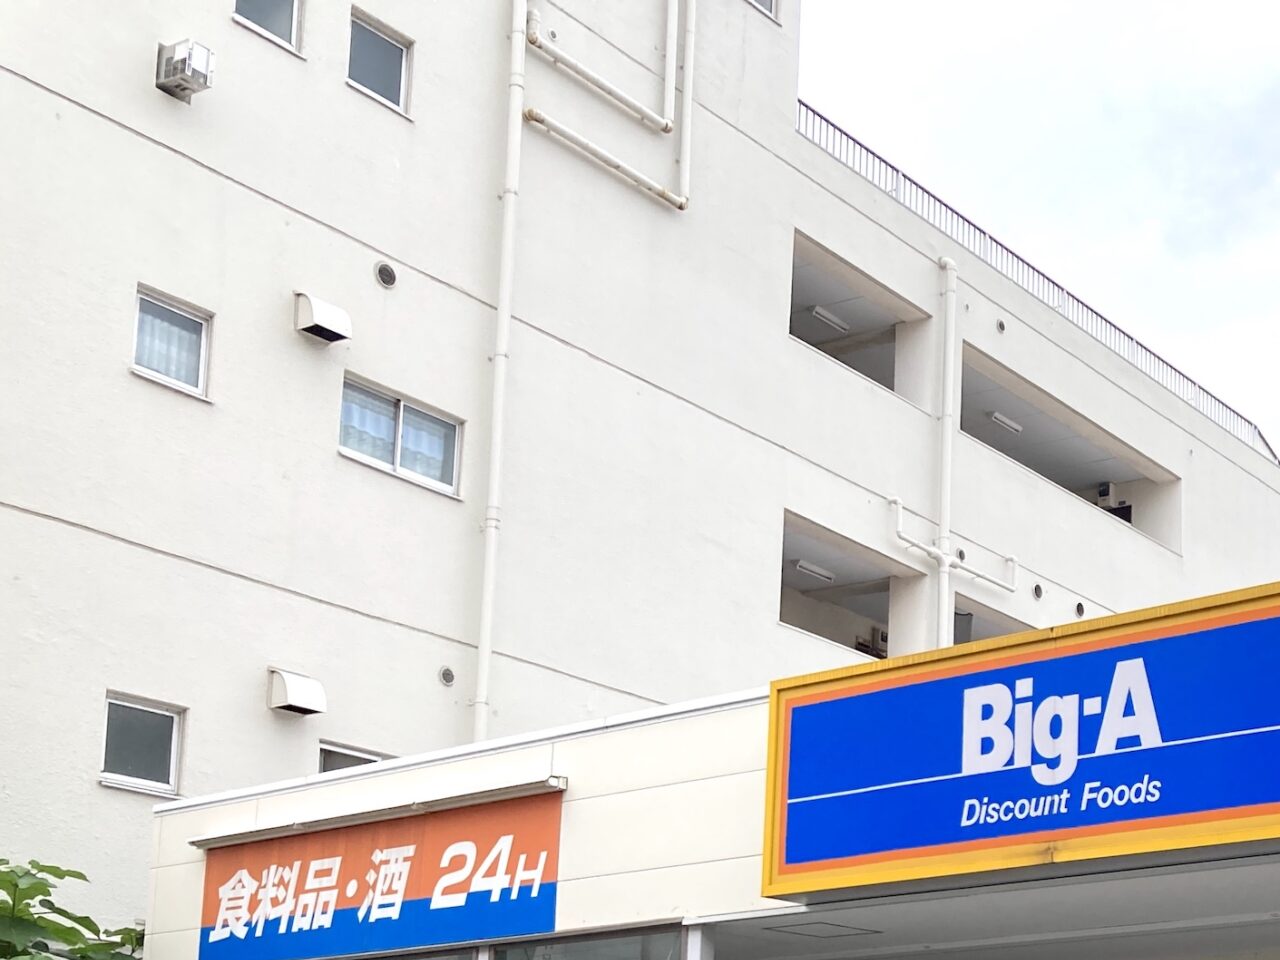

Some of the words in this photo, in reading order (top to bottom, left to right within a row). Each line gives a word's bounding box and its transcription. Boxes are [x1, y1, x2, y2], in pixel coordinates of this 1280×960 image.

[961, 657, 1163, 786] Big-A
[960, 793, 1069, 827] Discount
[1081, 774, 1162, 811] Foods
[208, 844, 417, 943] 食料品・酒
[430, 834, 548, 910] 24H
